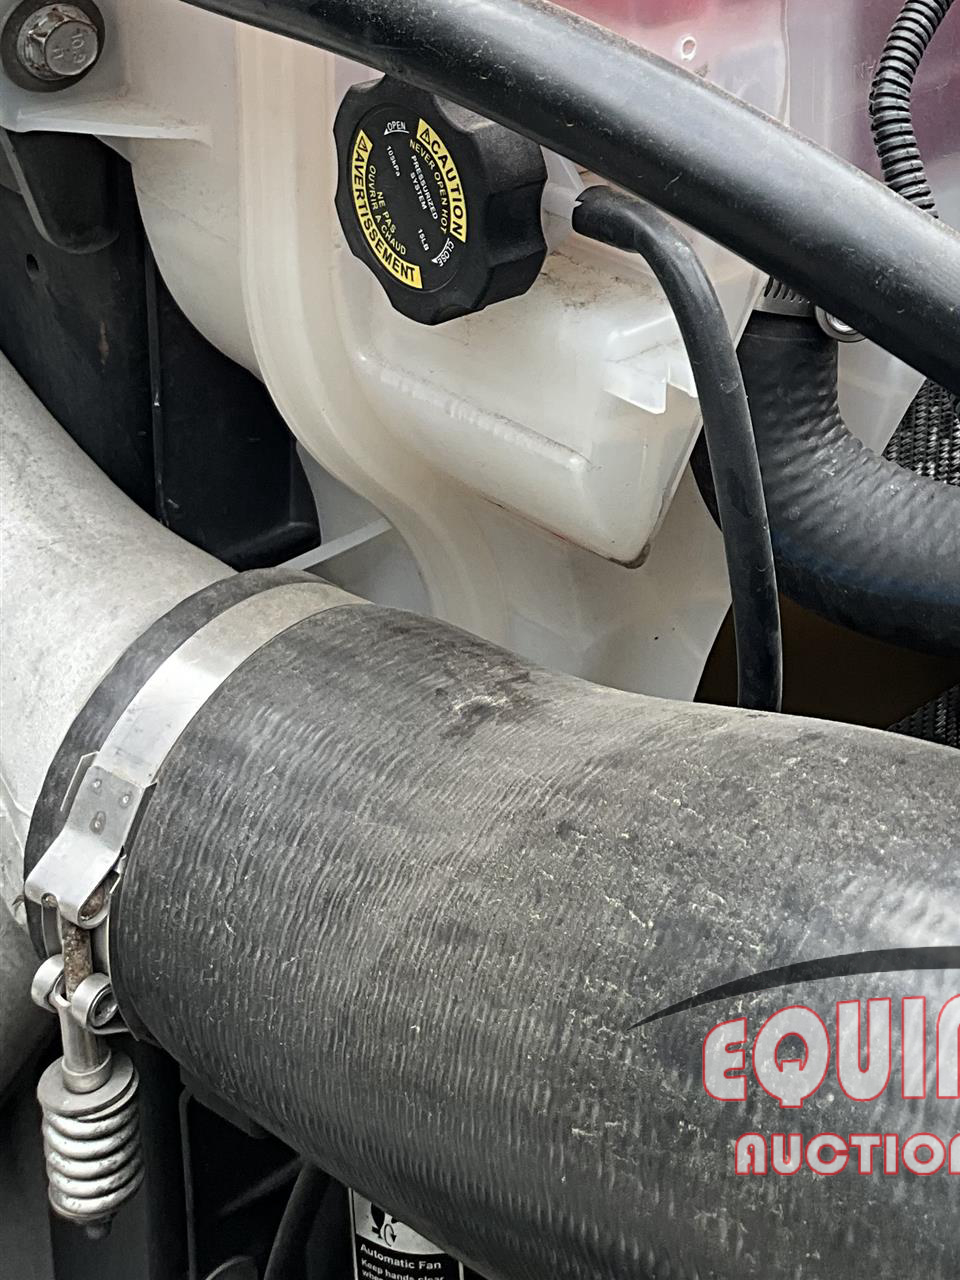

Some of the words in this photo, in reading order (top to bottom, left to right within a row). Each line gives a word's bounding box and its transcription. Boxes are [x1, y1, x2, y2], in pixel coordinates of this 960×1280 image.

[387, 120, 406, 131] OPEN
[409, 138, 436, 171] NEVER
[410, 172, 428, 210] SYSTEM
[411, 154, 438, 220] PRESSURIZED
[431, 140, 464, 237] CAUTION
[434, 171, 448, 206] OPEN
[353, 153, 416, 282] AVERTISSEMENT
[368, 165, 379, 211] OUVRIR
[380, 225, 407, 255] CHAUD
[376, 191, 386, 207] NE
[382, 211, 397, 234] PAS
[440, 208, 449, 234] HOT
[436, 240, 455, 267] CLOSE
[360, 1243, 415, 1269] Automatic
[418, 1260, 442, 1270] Fan
[361, 1258, 383, 1275] Keep
